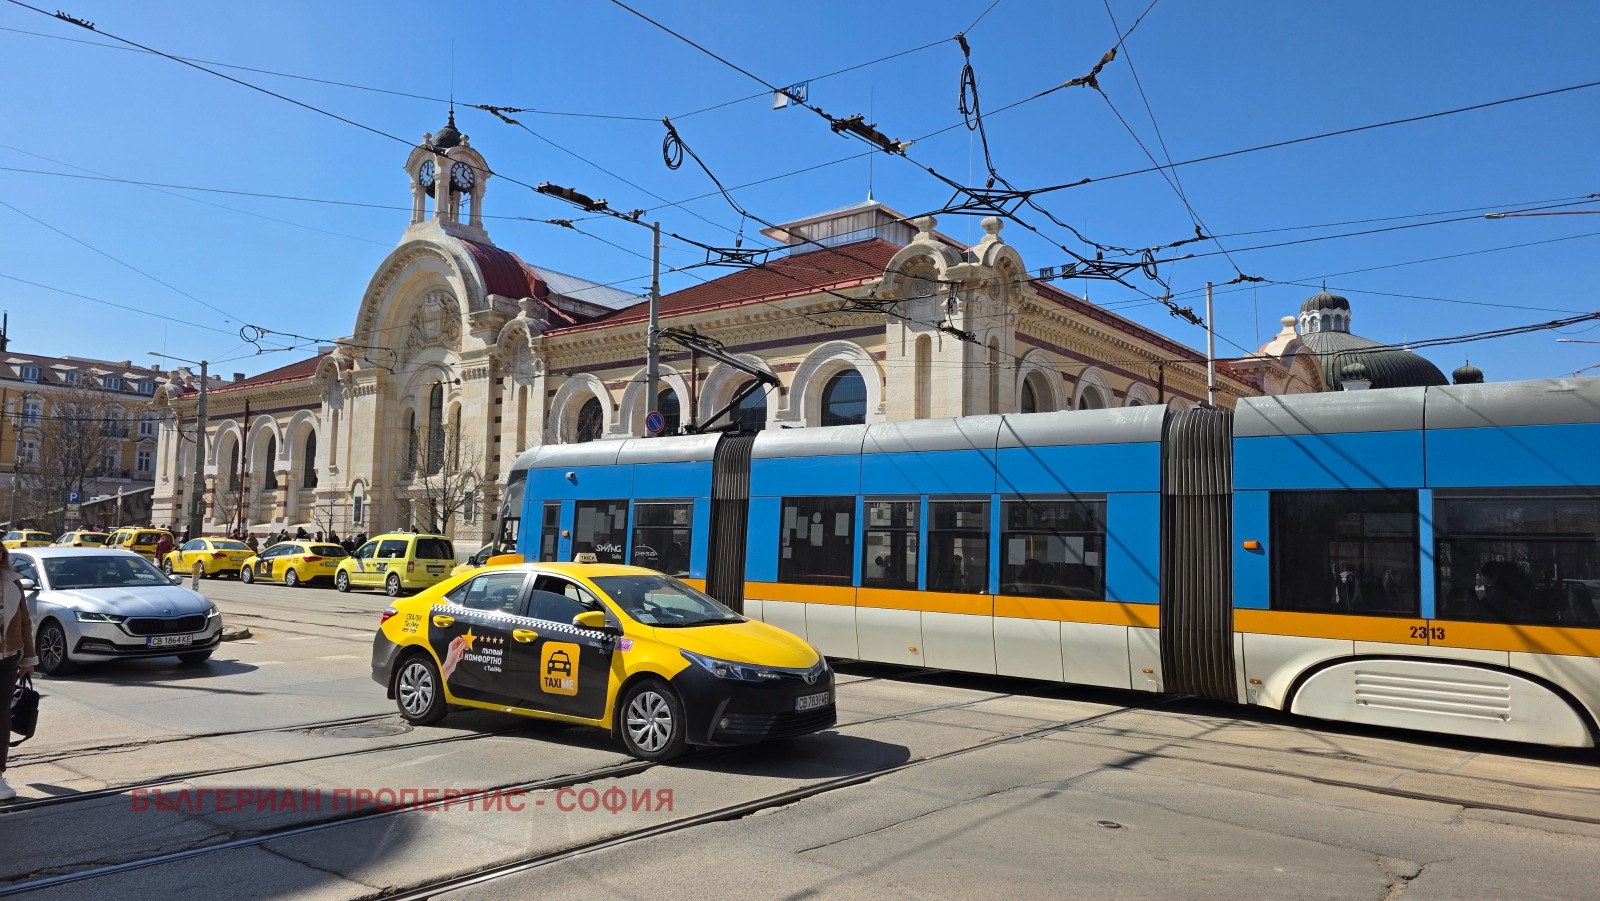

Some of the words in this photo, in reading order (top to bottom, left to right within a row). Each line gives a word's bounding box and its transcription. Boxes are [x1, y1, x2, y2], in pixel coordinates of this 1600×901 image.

[70, 493, 78, 502] P
[595, 544, 621, 552] SWING
[164, 636, 180, 644] 1864
[464, 653, 502, 665] КОМФОРТНО
